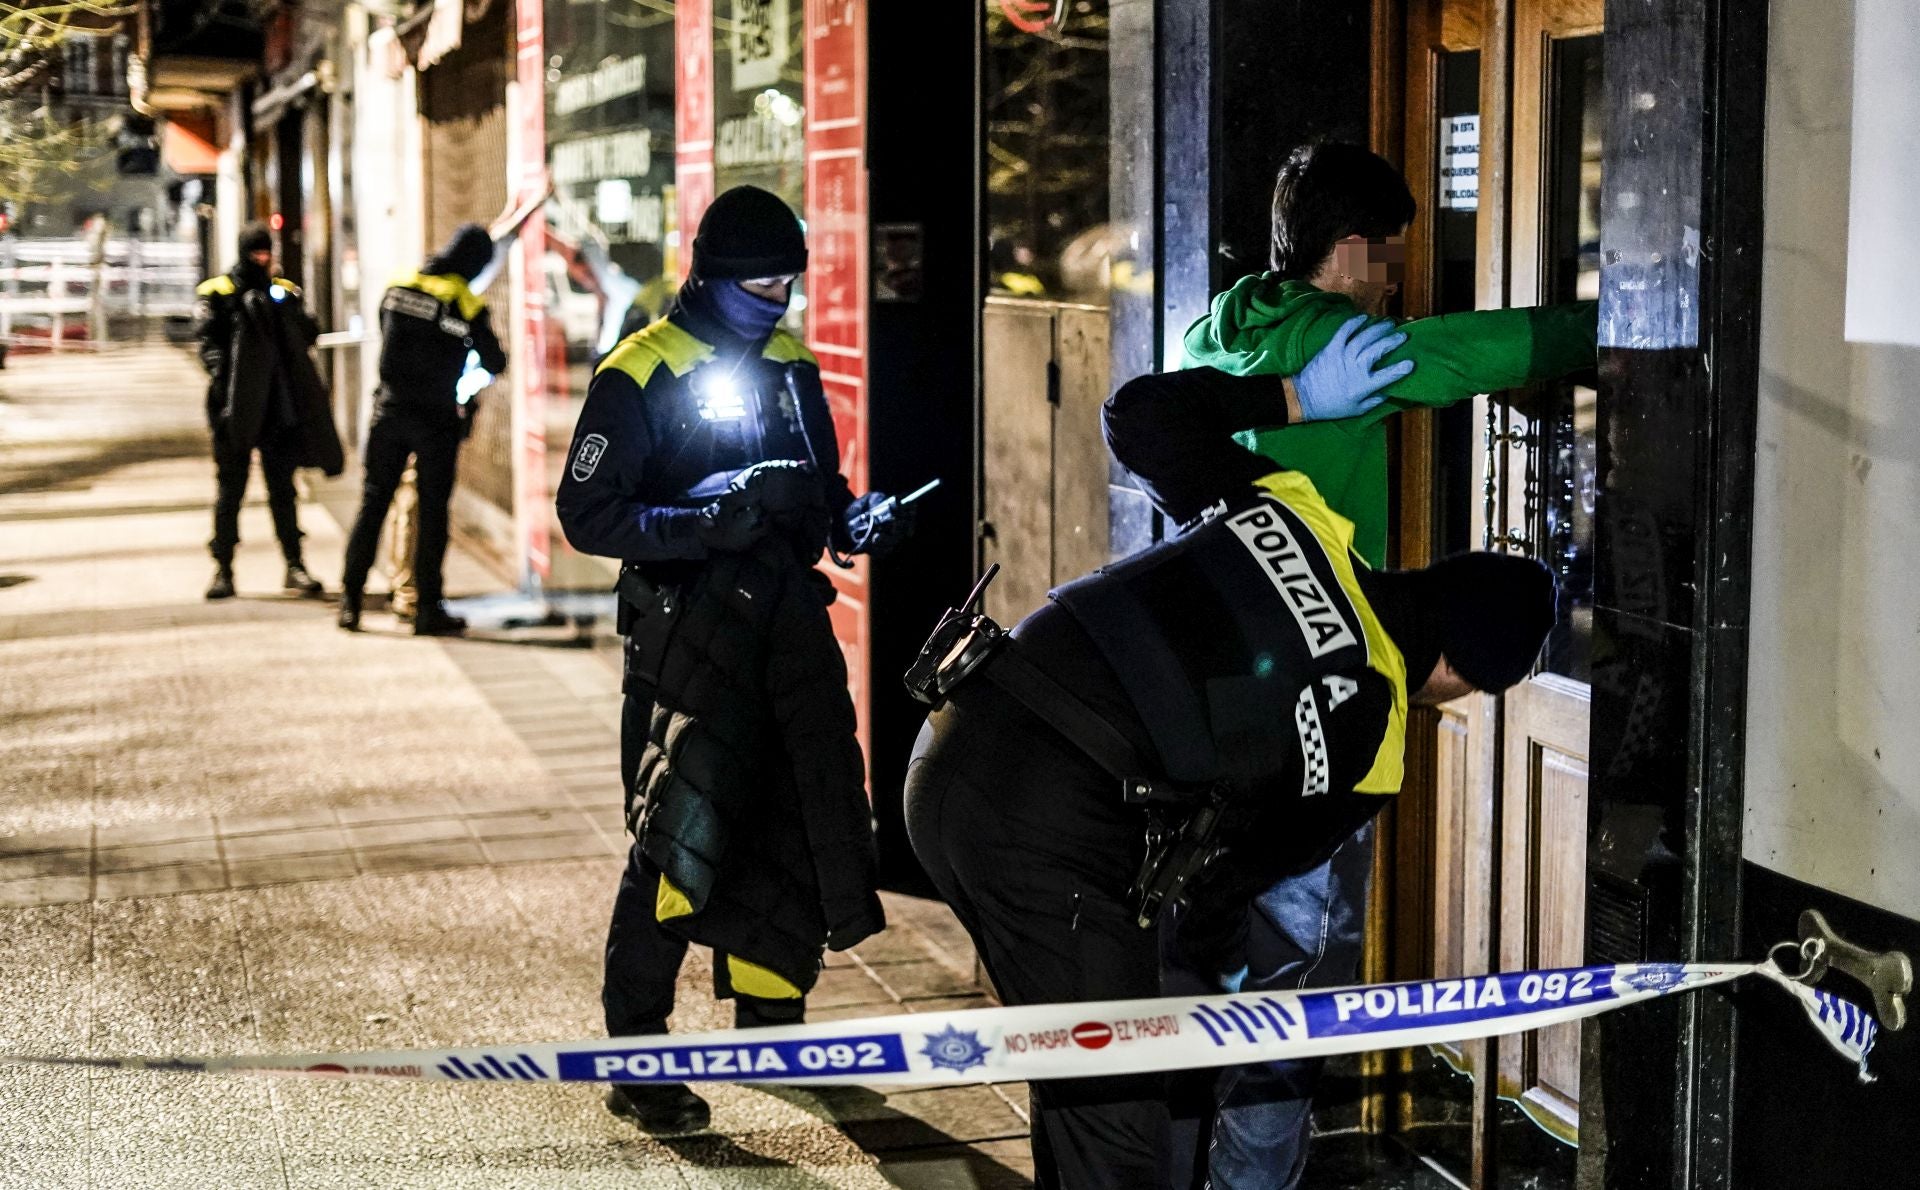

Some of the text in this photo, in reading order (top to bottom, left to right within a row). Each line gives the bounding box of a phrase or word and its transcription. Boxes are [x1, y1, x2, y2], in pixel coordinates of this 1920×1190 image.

[1236, 510, 1343, 650] POLIZIA
[1334, 972, 1594, 1022] POLIZIA 092
[1004, 1028, 1071, 1053] NO PASAR
[1115, 1014, 1180, 1041] EZ PASATU
[594, 1042, 885, 1077] POLIZIA 092
